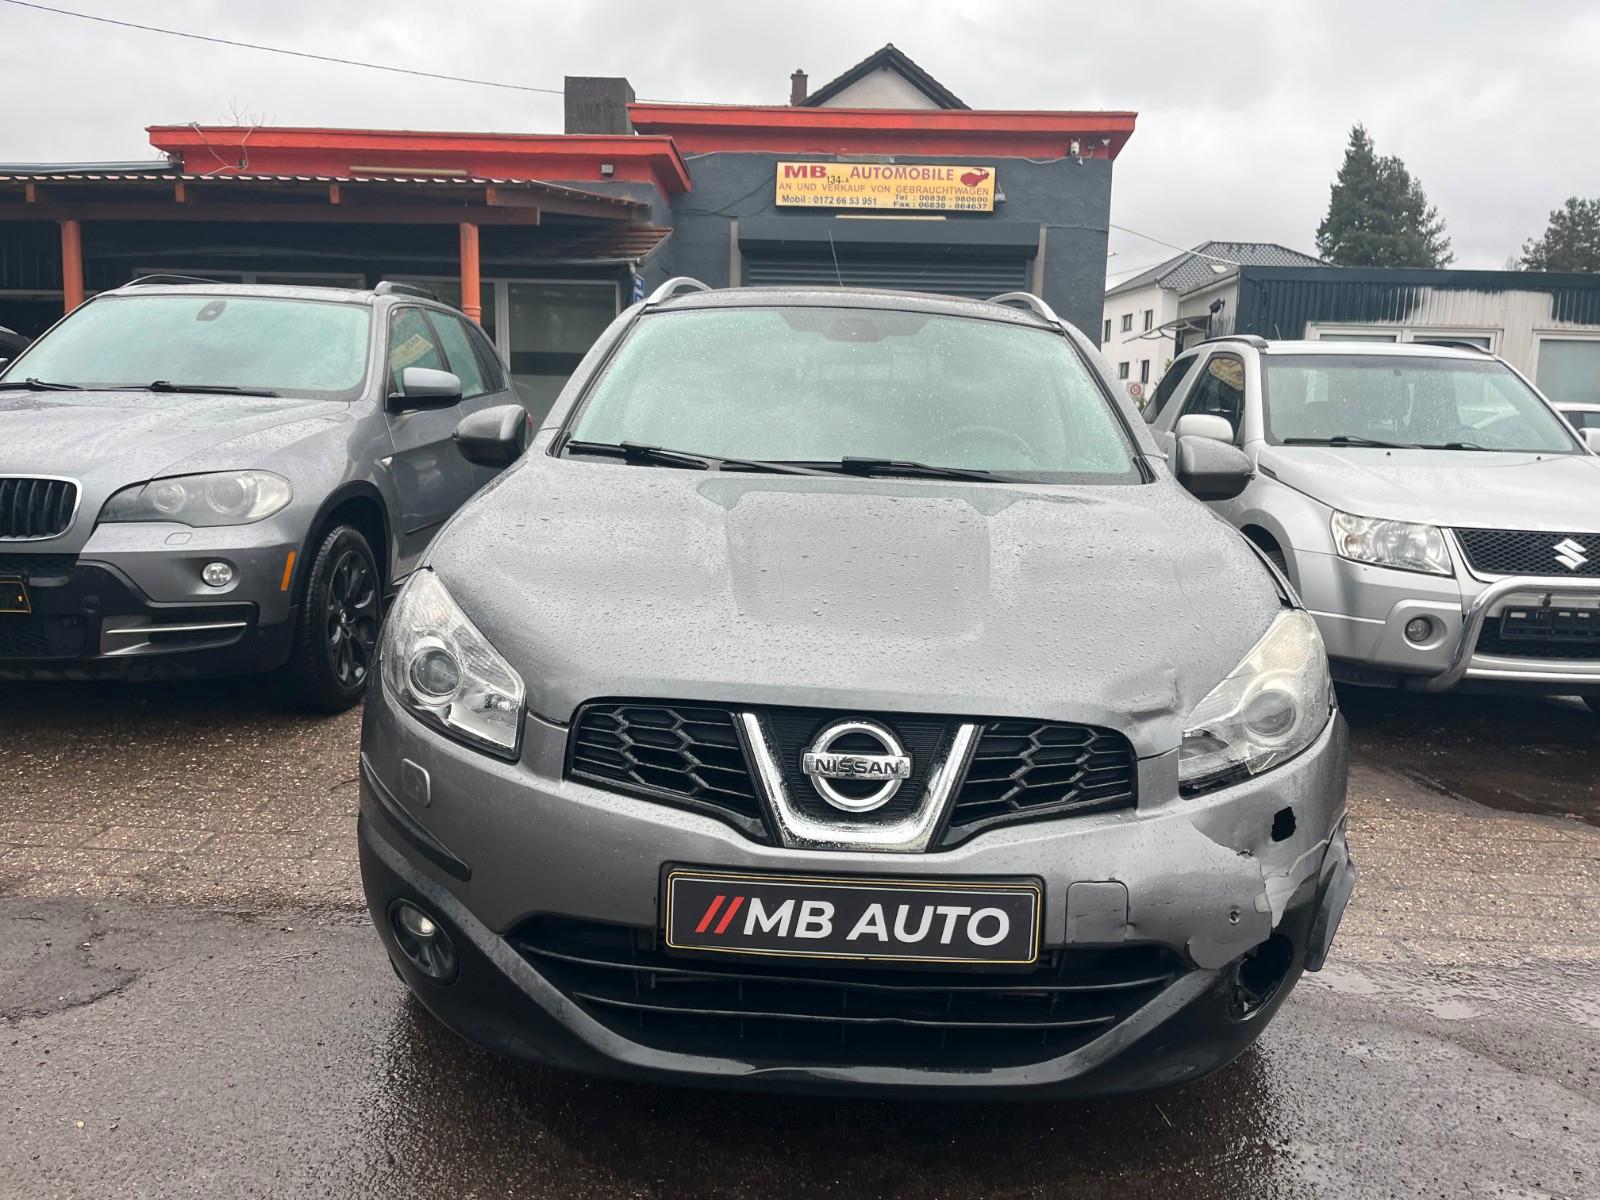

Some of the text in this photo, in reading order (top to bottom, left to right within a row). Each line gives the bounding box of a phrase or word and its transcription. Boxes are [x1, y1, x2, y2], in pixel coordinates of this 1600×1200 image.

[784, 165, 954, 181] MB AUTOMOBILE
[779, 182, 989, 196] AN UND VERKAUF VON GEBRAUCHTWAGEN
[813, 196, 834, 204] 0172
[836, 196, 847, 205] 66
[849, 197, 860, 205] 53
[815, 758, 899, 775] NISSAN
[846, 903, 1010, 946] AUTO
